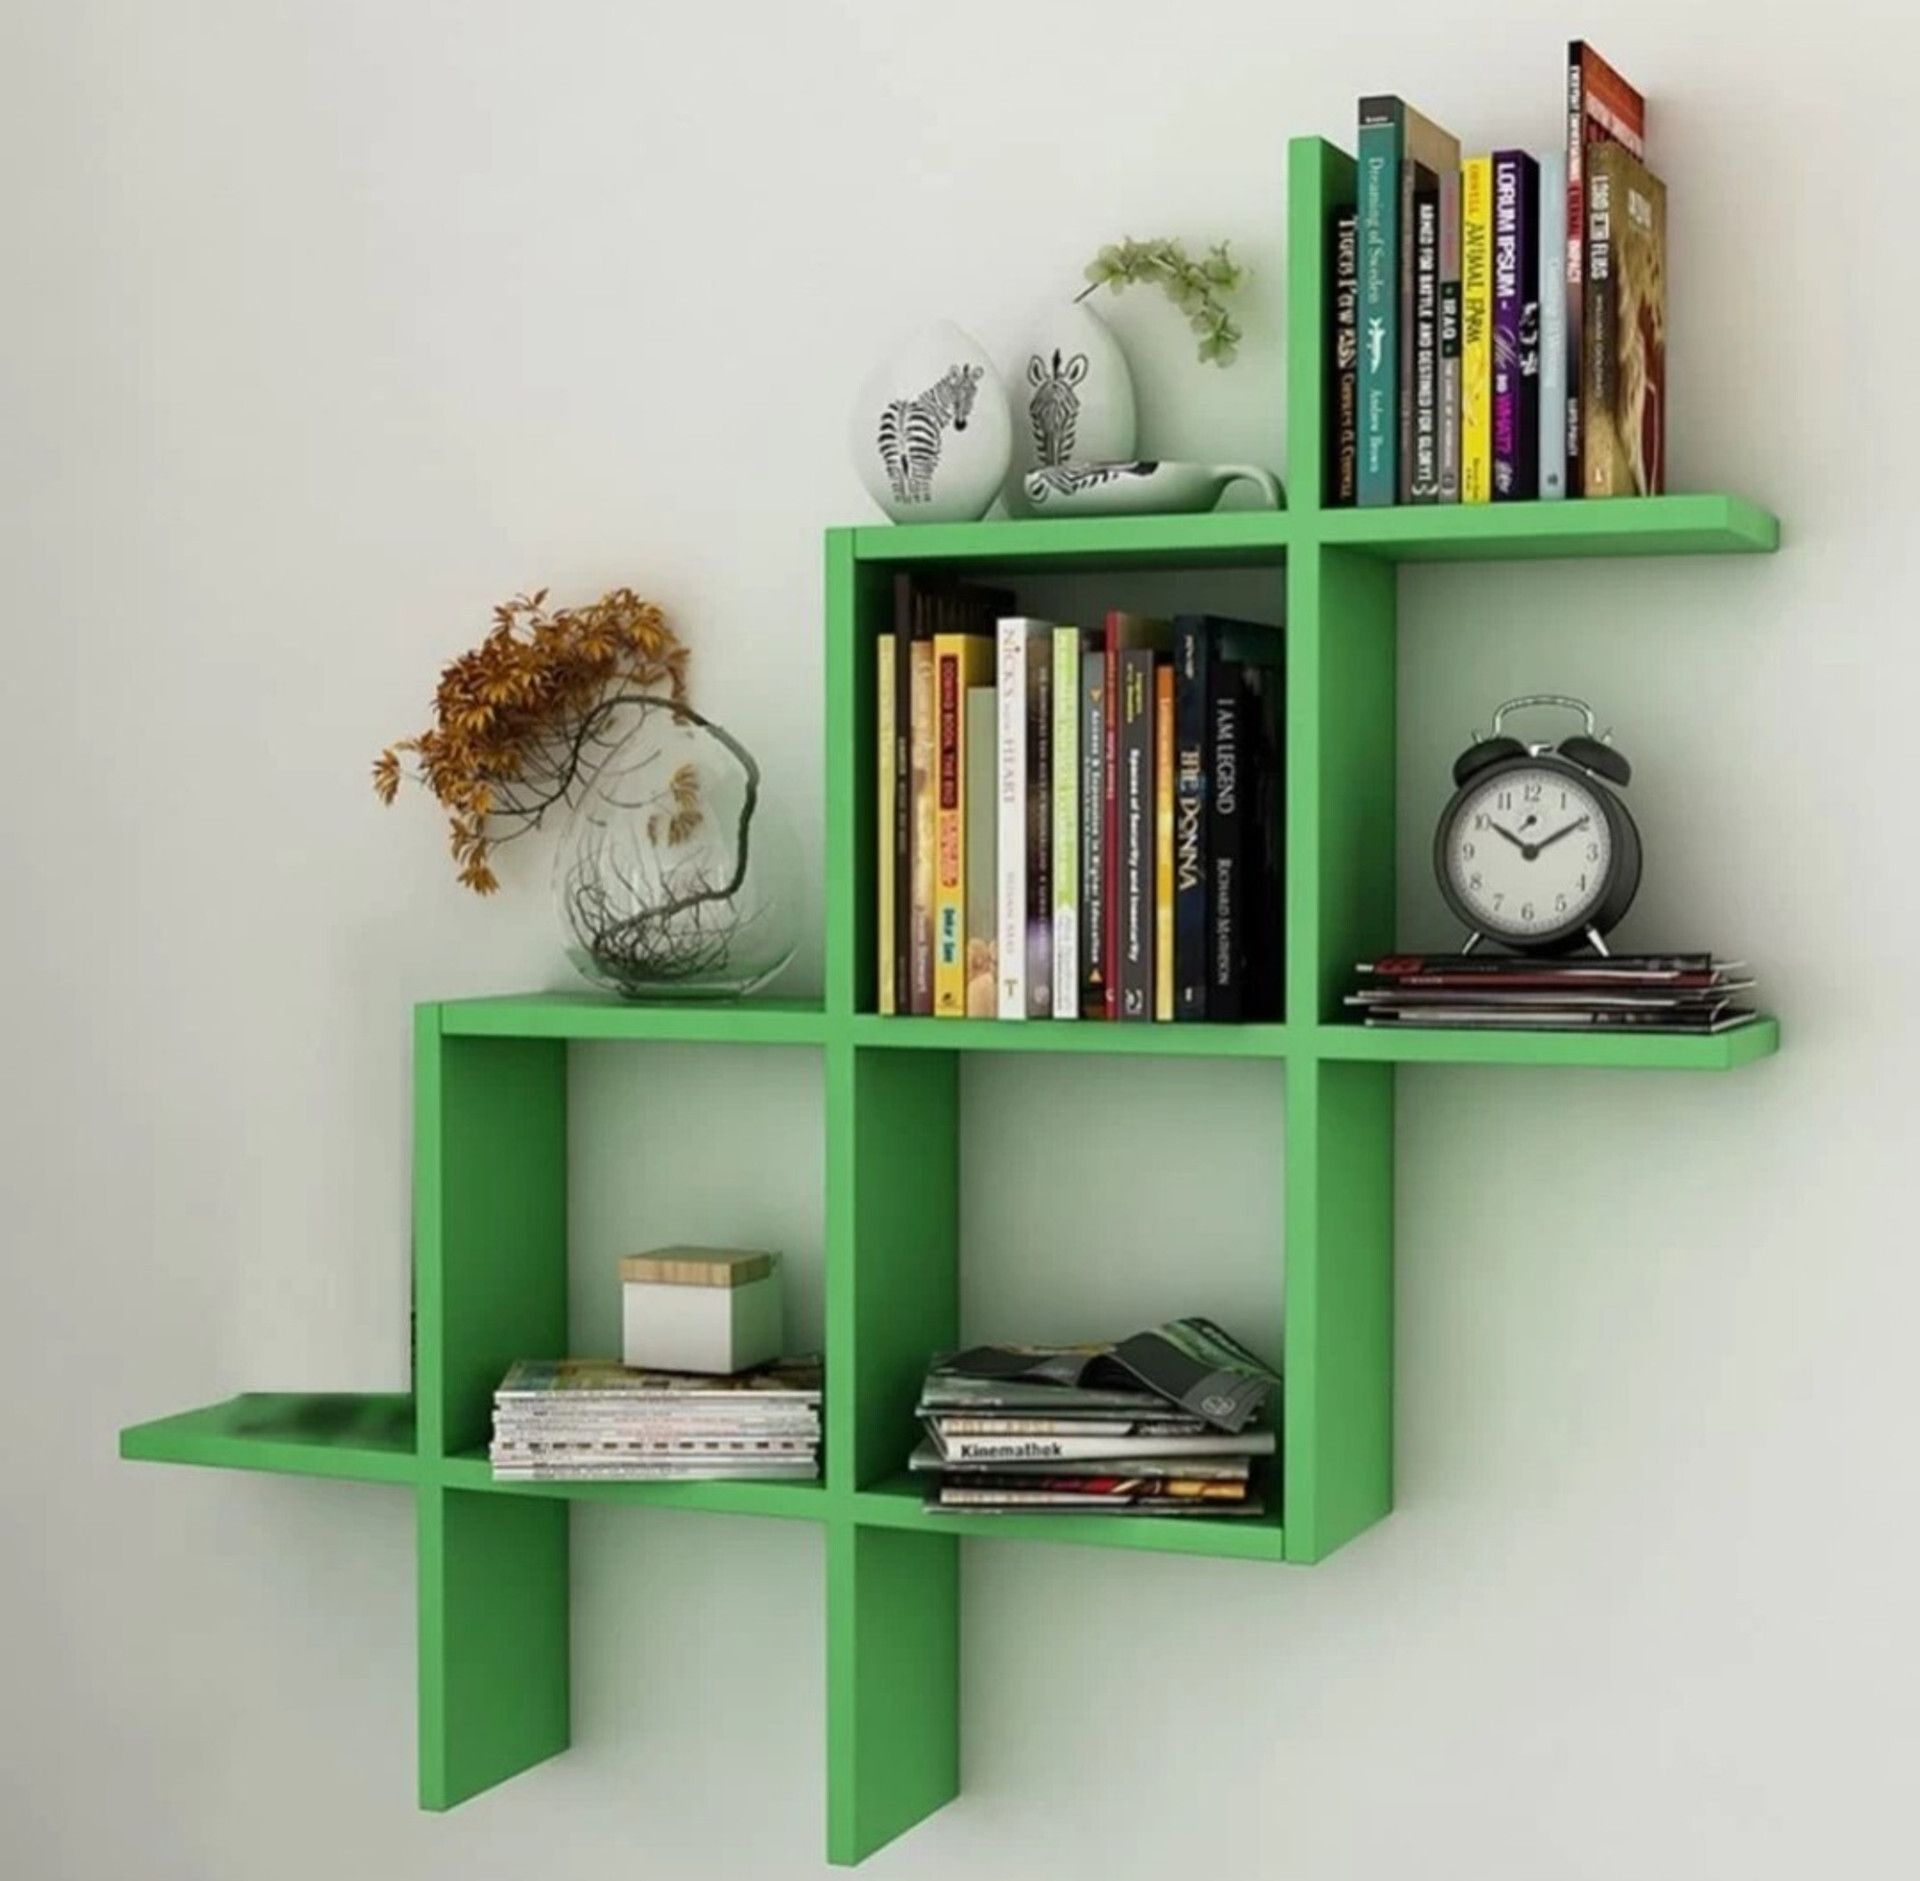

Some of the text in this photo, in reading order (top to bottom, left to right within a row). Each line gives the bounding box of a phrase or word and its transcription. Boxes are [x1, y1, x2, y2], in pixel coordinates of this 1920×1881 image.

[1497, 162, 1516, 232] LORUM
[1364, 157, 1385, 304] Dreaming of Sweden
[1419, 247, 1434, 271] FOR
[1466, 222, 1485, 291] ANIMAL
[1497, 235, 1516, 298] IPSUM
[1418, 274, 1434, 317] BATTLE
[1418, 321, 1433, 348] AND
[1443, 298, 1458, 340] IRAQ
[1465, 297, 1486, 345] FARM
[1418, 350, 1433, 407] DESTINED
[1418, 409, 1433, 433] FOR
[1217, 709, 1235, 741] AM
[1003, 738, 1016, 803] HEART
[1216, 744, 1235, 814] LEGEND
[1498, 792, 1511, 810] 11
[1524, 784, 1541, 801] 12
[1127, 749, 1140, 962] Spaces of Security and Insecurity
[1178, 795, 1202, 891] DONNA
[1463, 843, 1475, 860] 9
[1587, 844, 1598, 862] 3
[1470, 872, 1482, 890] 8
[1493, 893, 1504, 912] 7
[1521, 902, 1534, 922] 6
[1555, 893, 1567, 912] 5
[1091, 900, 1102, 963] Education
[960, 1442, 1062, 1458] Kinemathek
